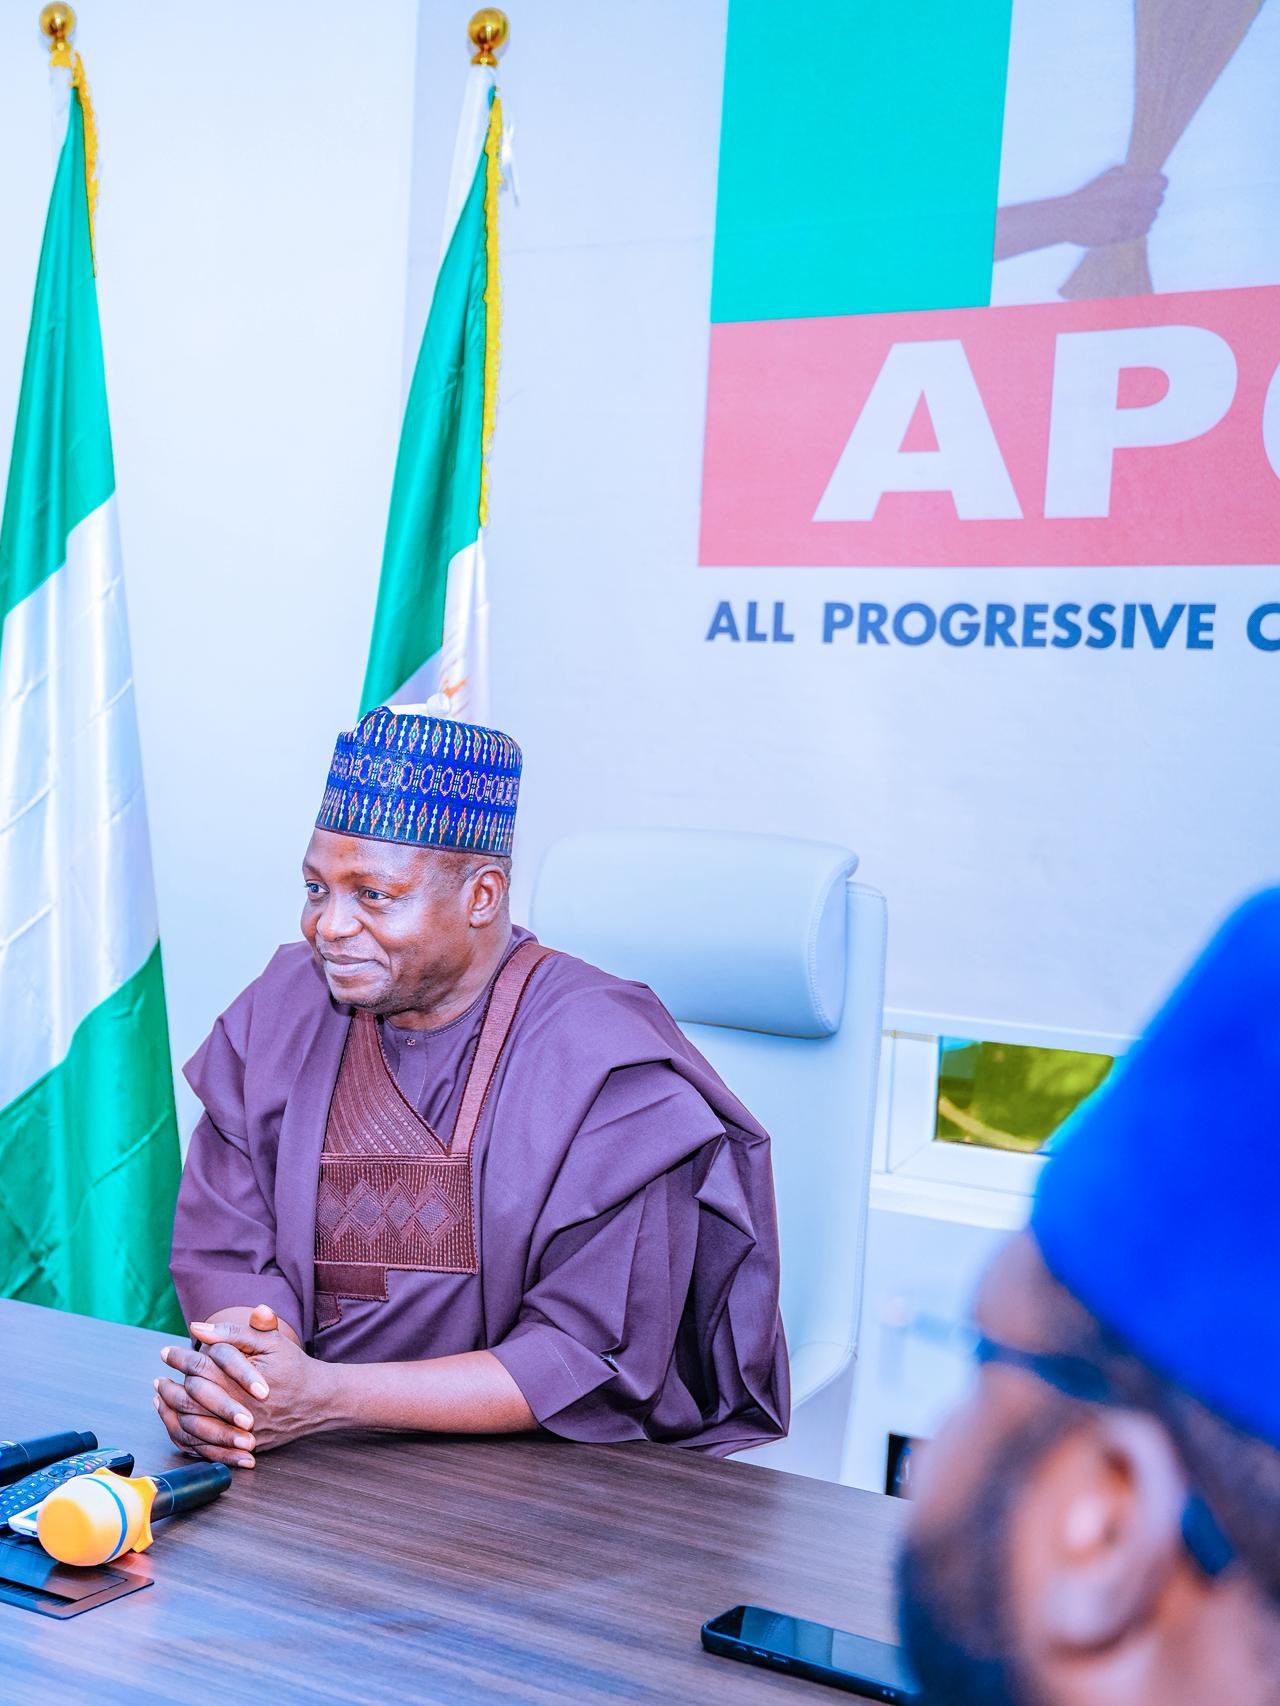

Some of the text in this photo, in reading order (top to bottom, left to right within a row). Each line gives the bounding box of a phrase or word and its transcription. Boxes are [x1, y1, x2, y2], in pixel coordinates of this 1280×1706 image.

[812, 325, 1280, 521] AP
[705, 601, 794, 642] ALL
[822, 603, 1216, 649] PROGRESSIVE
